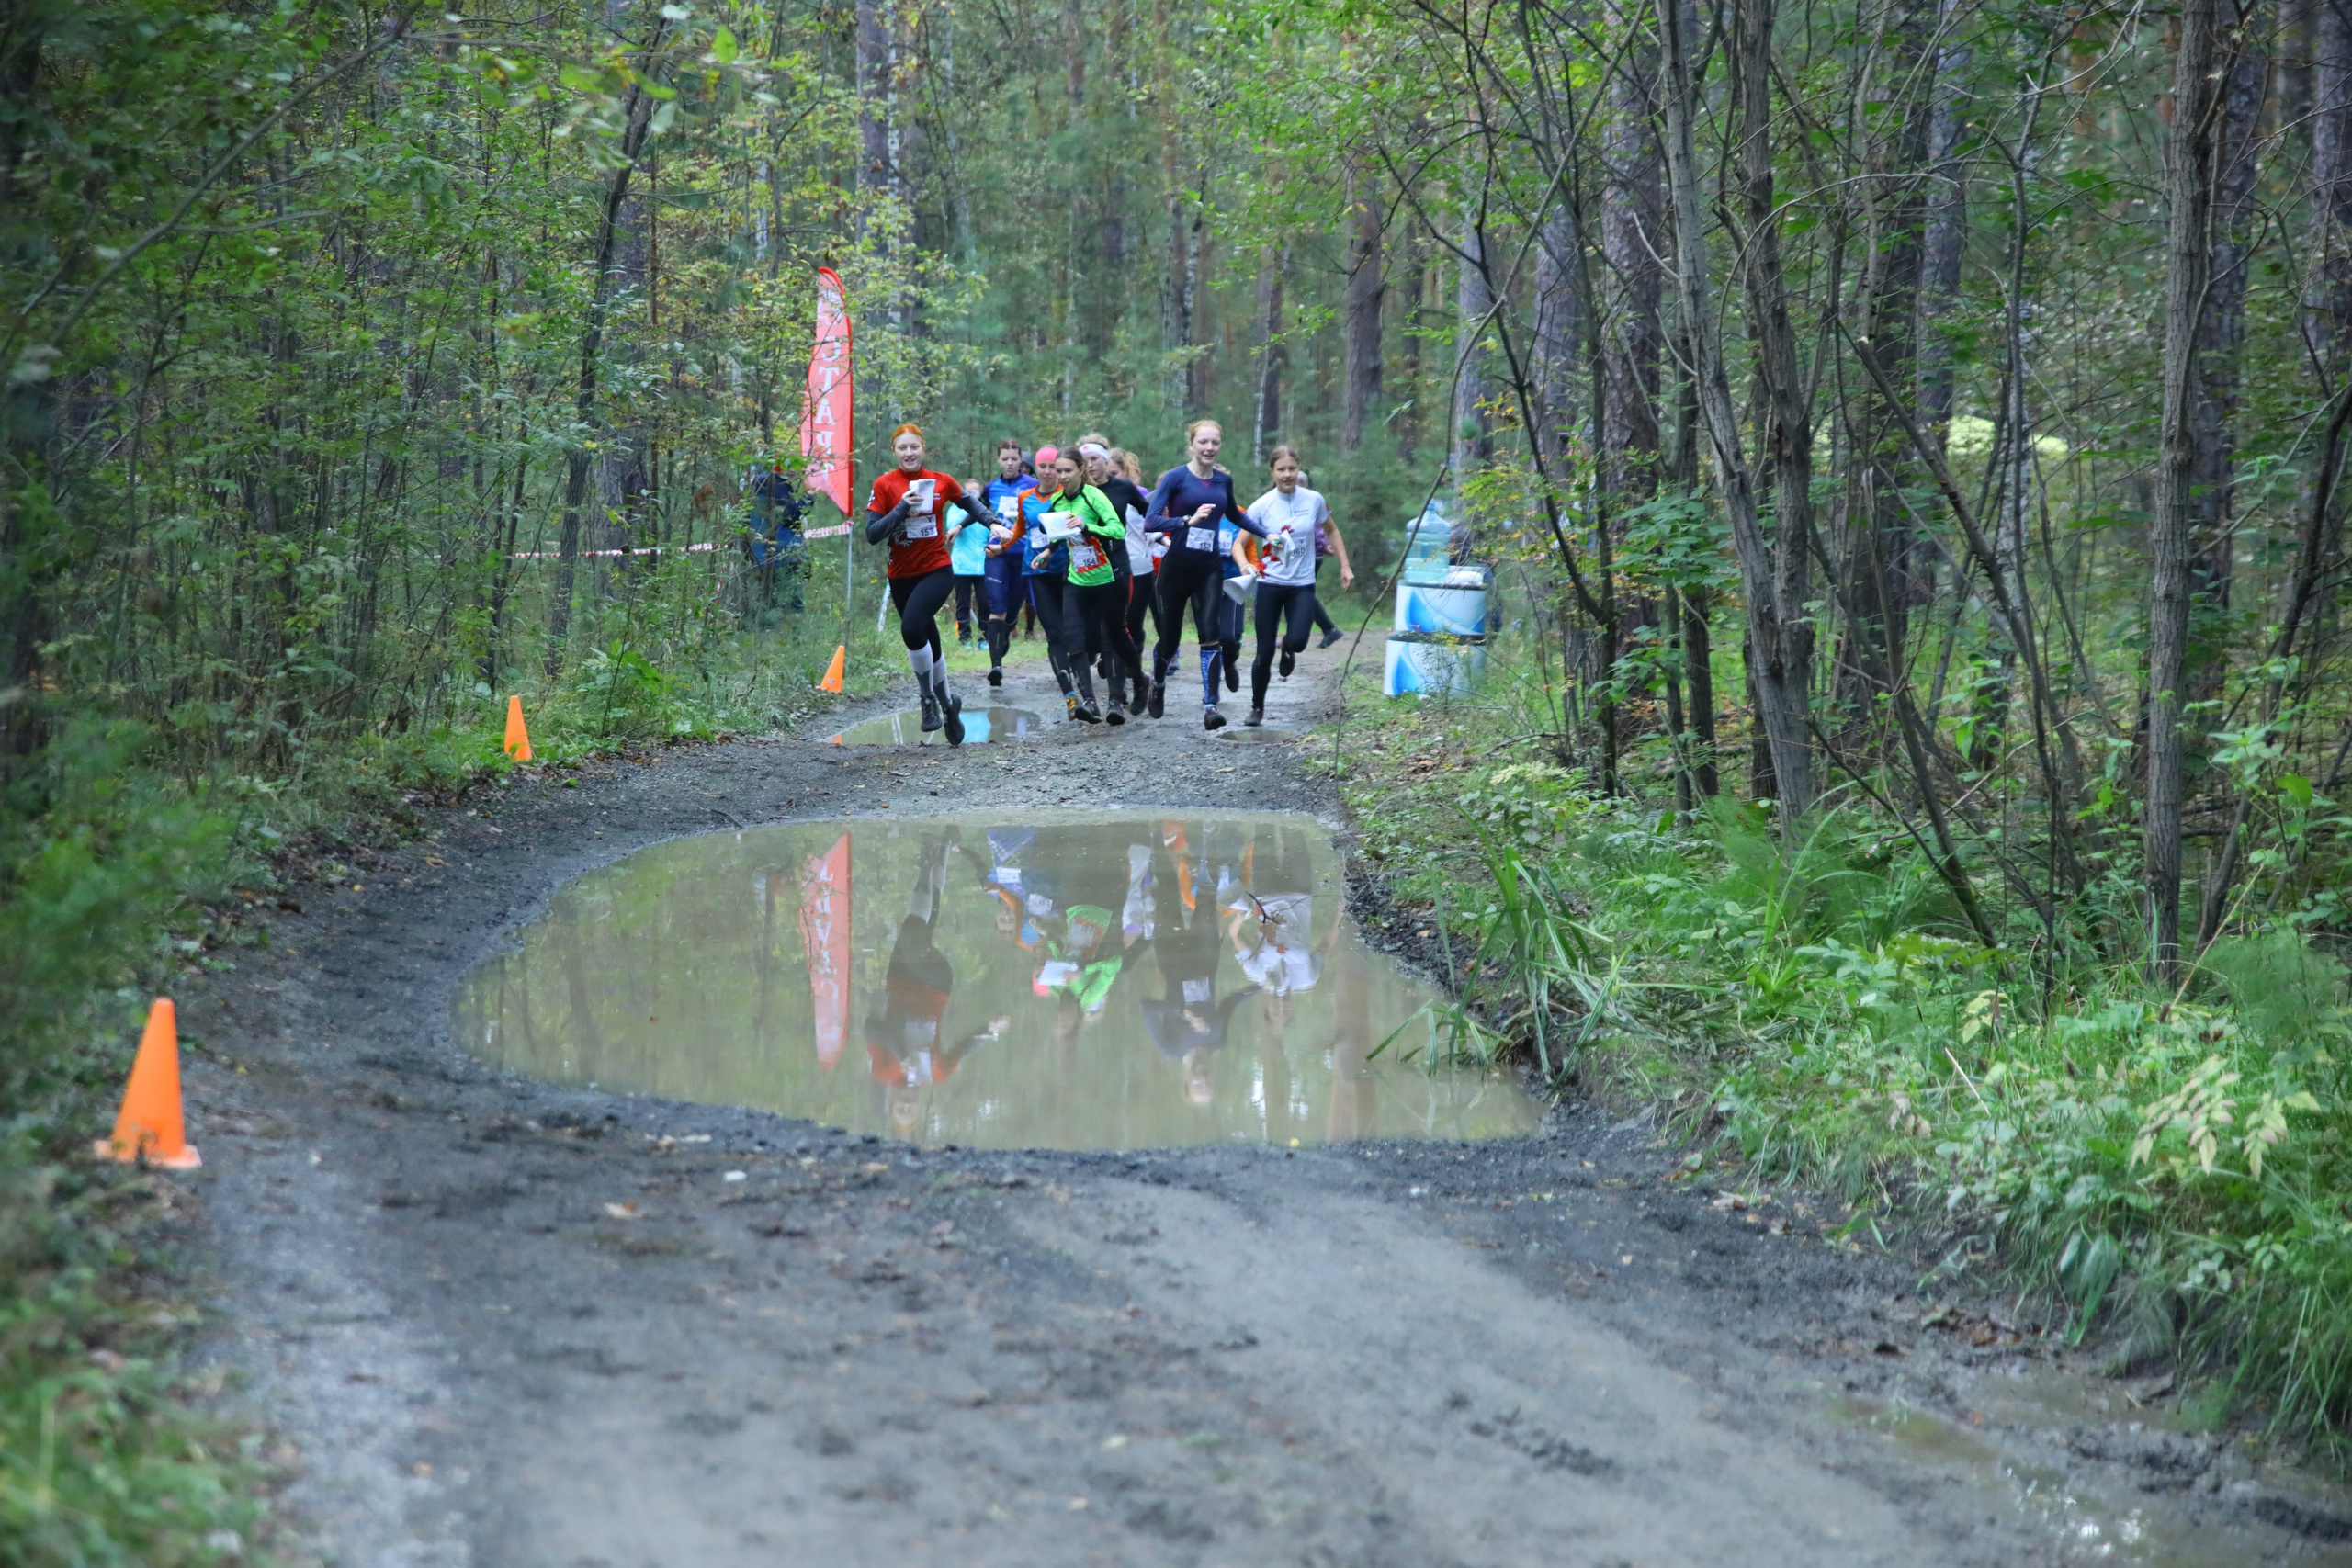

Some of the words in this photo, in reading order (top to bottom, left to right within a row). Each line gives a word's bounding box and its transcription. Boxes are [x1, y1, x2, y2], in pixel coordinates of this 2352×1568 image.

[921, 527, 934, 536] 153
[1199, 542, 1212, 550] 152
[1083, 558, 1096, 567] 154
